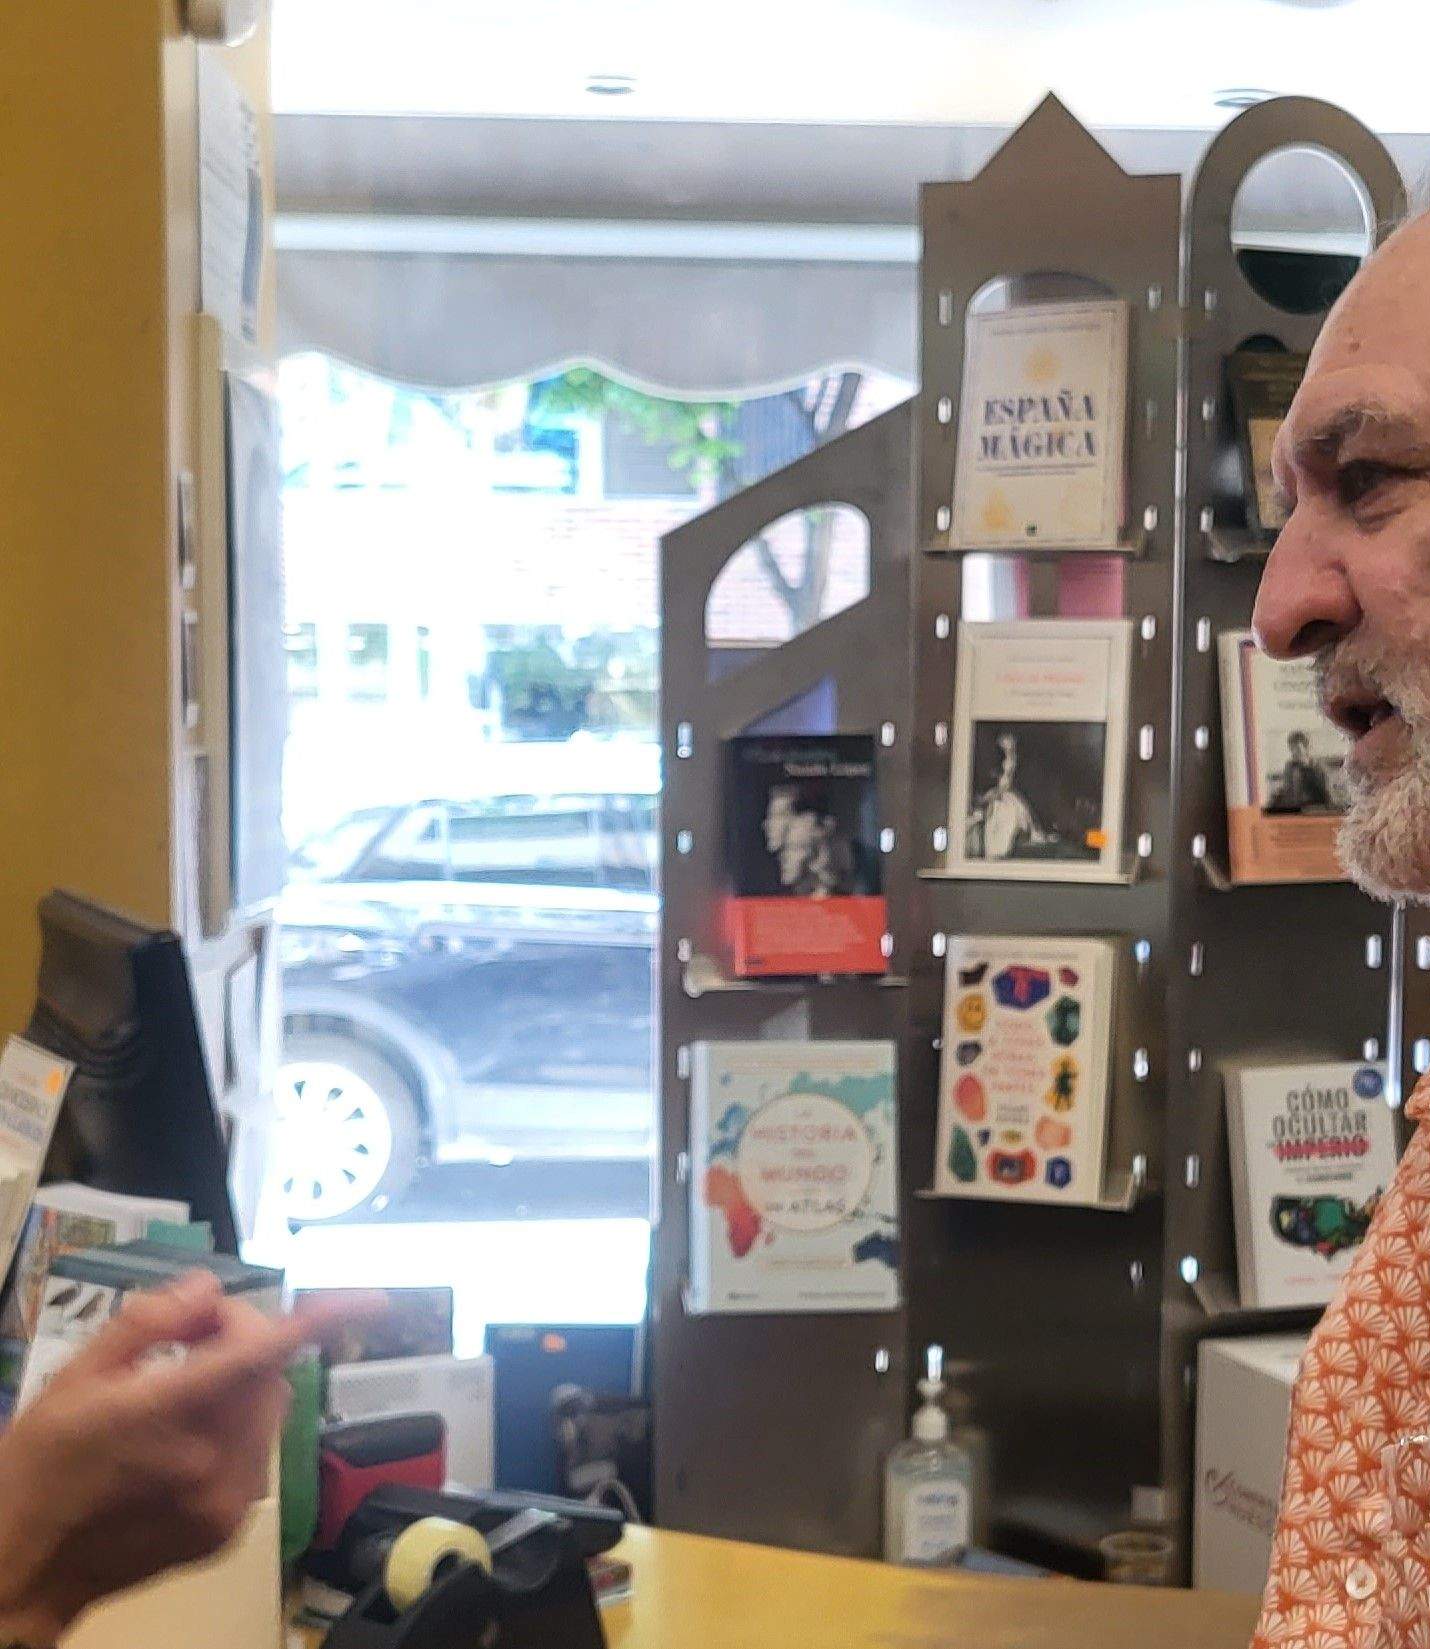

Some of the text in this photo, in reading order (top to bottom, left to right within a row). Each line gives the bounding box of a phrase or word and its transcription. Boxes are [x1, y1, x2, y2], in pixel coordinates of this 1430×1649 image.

[984, 390, 1096, 427] ESPAÑA
[977, 427, 1097, 462] MÁGICA
[1285, 1080, 1349, 1112] CÓMO
[751, 1124, 857, 1142] HISTORIA
[1271, 1109, 1368, 1140] OCULTAR
[1276, 1134, 1371, 1163] IMPERIO
[760, 1164, 849, 1182] MUNDO
[788, 1199, 846, 1214] ATLAS
